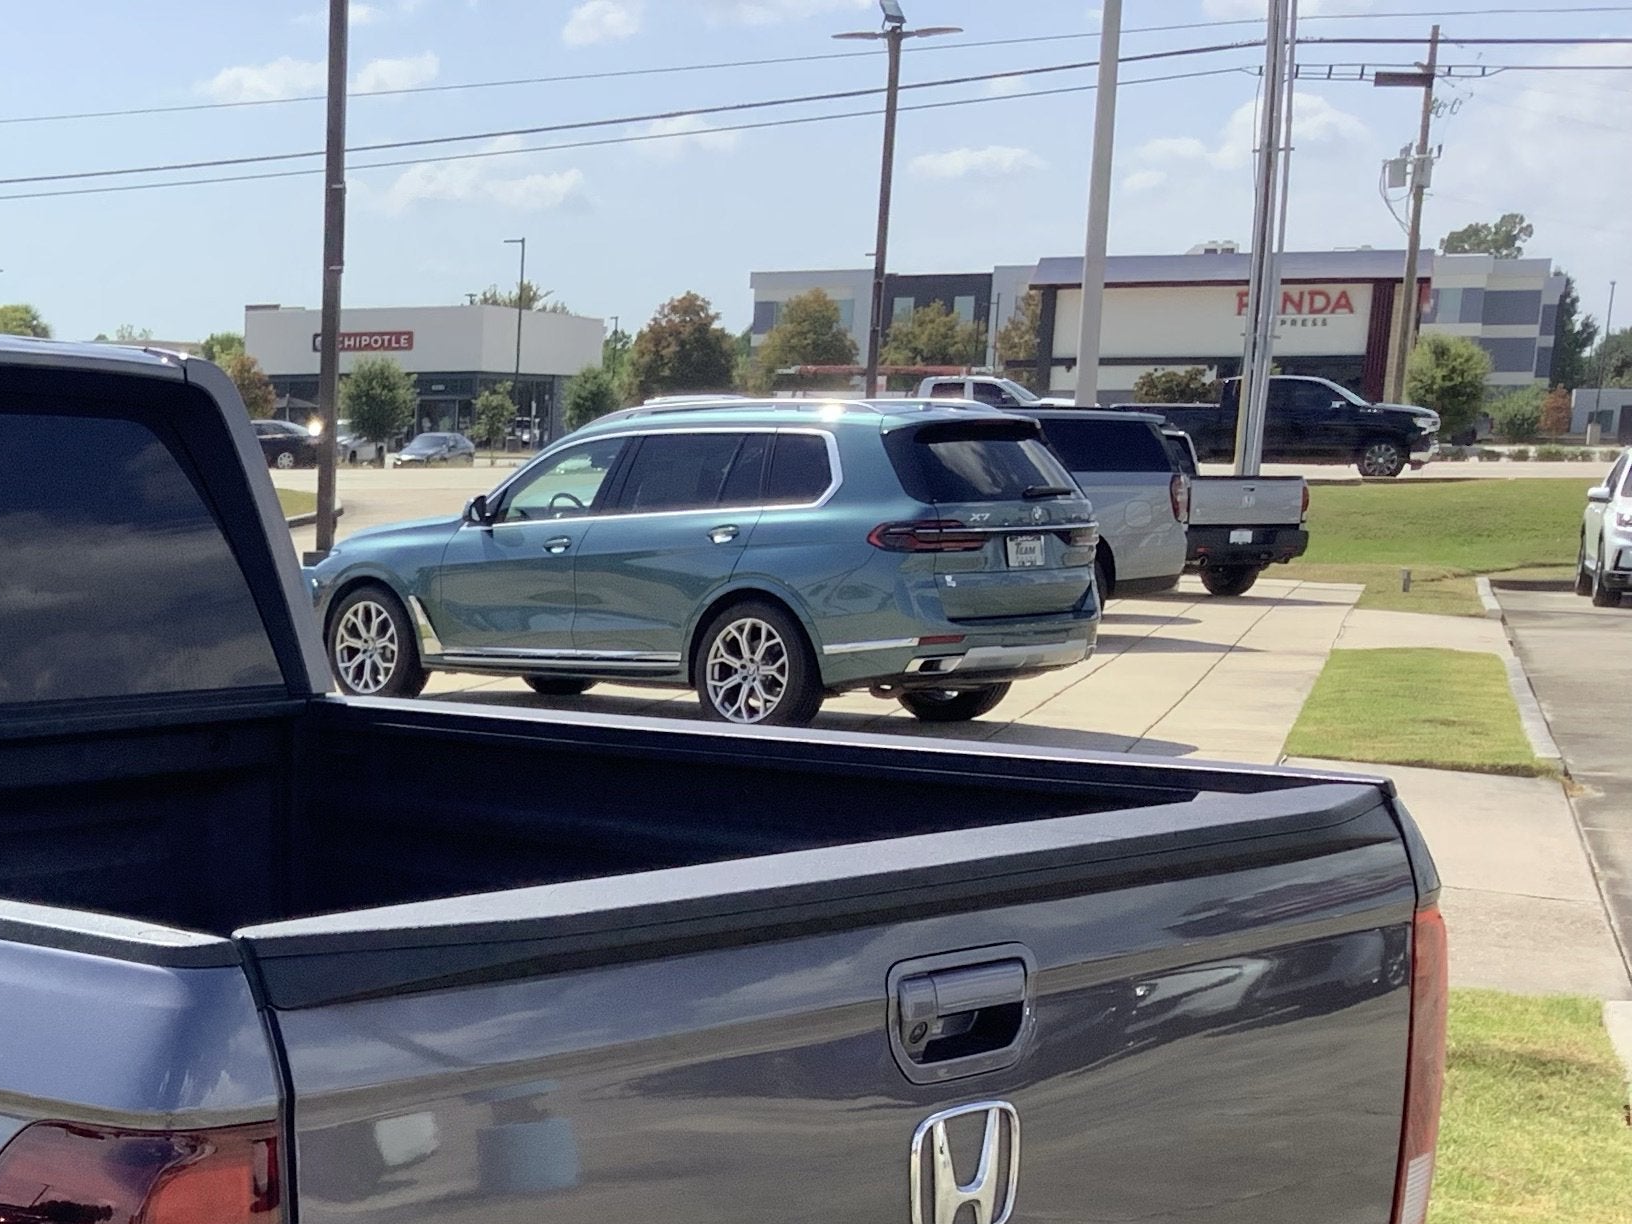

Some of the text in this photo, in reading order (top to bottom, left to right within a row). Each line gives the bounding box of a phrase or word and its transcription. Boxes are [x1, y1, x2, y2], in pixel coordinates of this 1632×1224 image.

[1235, 290, 1354, 316] PNDA
[1280, 318, 1328, 327] PRESS
[970, 513, 991, 522] X7
